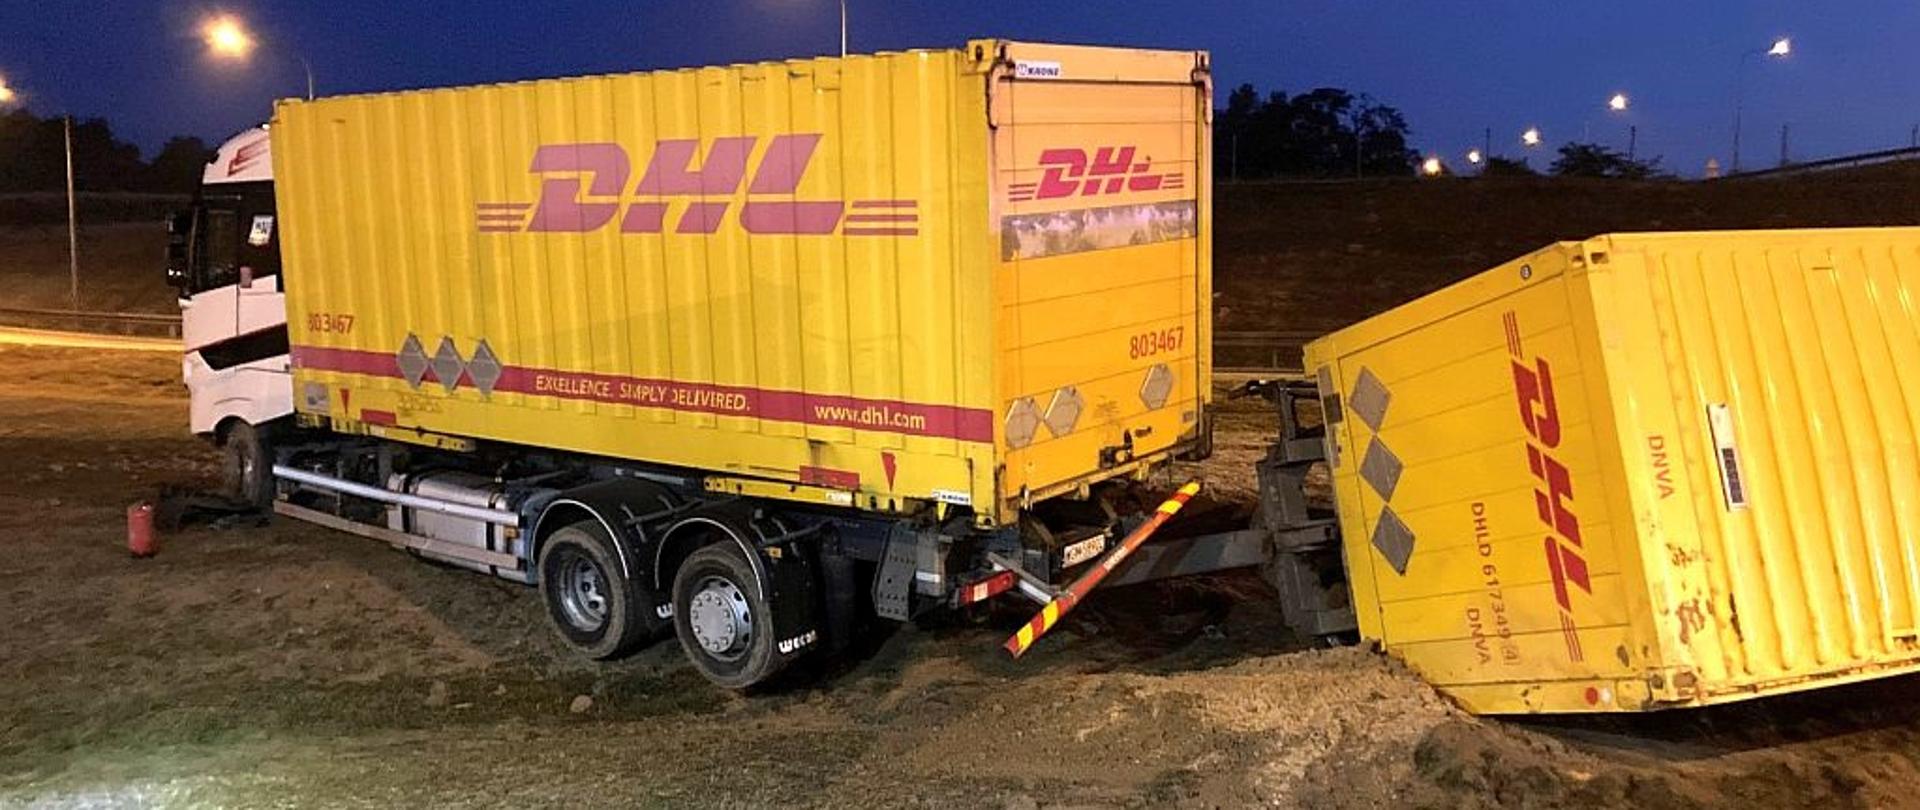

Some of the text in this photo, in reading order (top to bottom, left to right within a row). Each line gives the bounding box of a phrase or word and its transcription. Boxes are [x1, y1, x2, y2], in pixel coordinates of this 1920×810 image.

[526, 133, 845, 234] DHL
[1036, 146, 1163, 199] DHL
[1129, 326, 1184, 360] 803467
[619, 381, 667, 402] SIMPLY
[814, 405, 926, 430] www.dhl.com
[1511, 356, 1592, 614] DHL
[1648, 436, 1674, 499] DNVA
[1471, 502, 1492, 557] DHLD
[1482, 564, 1512, 639] 617349
[1467, 608, 1491, 665] DNVA
